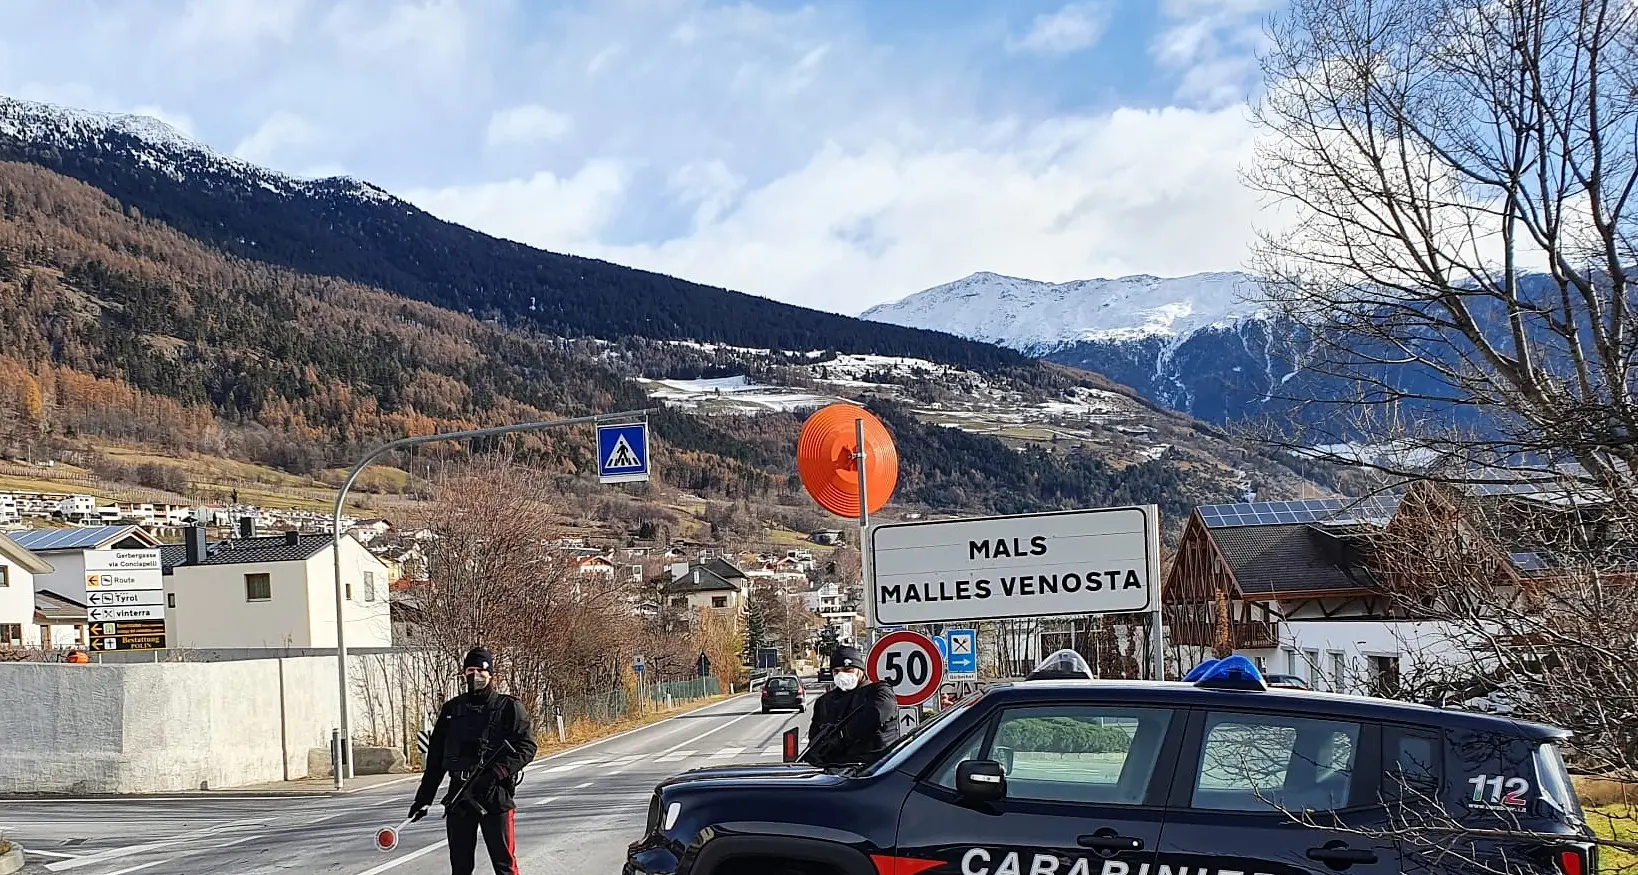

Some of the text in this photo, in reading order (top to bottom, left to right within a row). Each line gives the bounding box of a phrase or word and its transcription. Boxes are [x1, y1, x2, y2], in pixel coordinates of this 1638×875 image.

[969, 535, 1048, 560] MALS
[115, 594, 138, 603] Tyrol
[881, 569, 1142, 605] MALLES VENOSTA
[116, 609, 151, 617] vinterra
[122, 635, 160, 644] Bestattung
[884, 650, 928, 687] 50
[1468, 774, 1529, 805] 112
